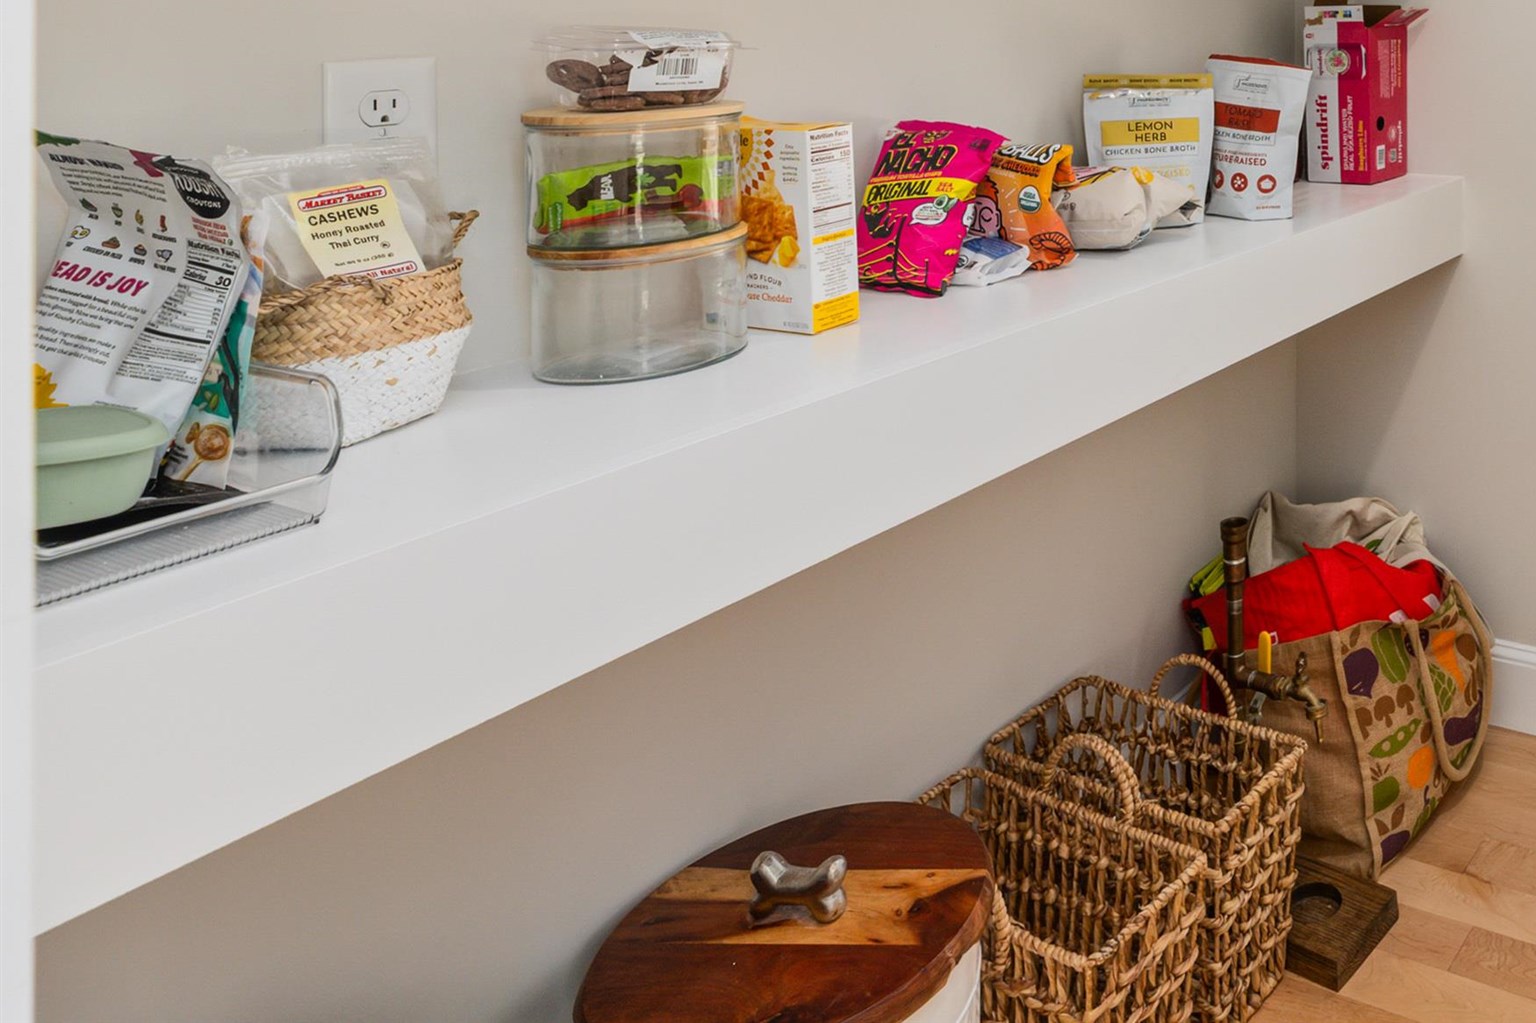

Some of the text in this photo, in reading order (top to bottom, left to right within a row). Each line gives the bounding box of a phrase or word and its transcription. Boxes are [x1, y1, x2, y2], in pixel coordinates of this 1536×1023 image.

[1127, 121, 1173, 132] LEMON
[1315, 94, 1334, 170] spindrift
[1135, 132, 1167, 142] HERB
[1105, 147, 1142, 156] CHICKEN
[1144, 146, 1167, 154] BONE
[875, 144, 958, 177] NACHO
[302, 189, 383, 210] MARKET BASKET
[867, 180, 932, 204] ORIGINAL
[186, 195, 222, 210] CROUTONS
[308, 204, 380, 227] CASHEWS
[311, 219, 386, 241] Honey Roasted
[329, 235, 380, 250] Thai Curry
[380, 263, 414, 276] Natural
[51, 259, 149, 297] EAD IS JOY
[760, 274, 782, 287] FLOUR
[761, 292, 793, 304] Cheddar
